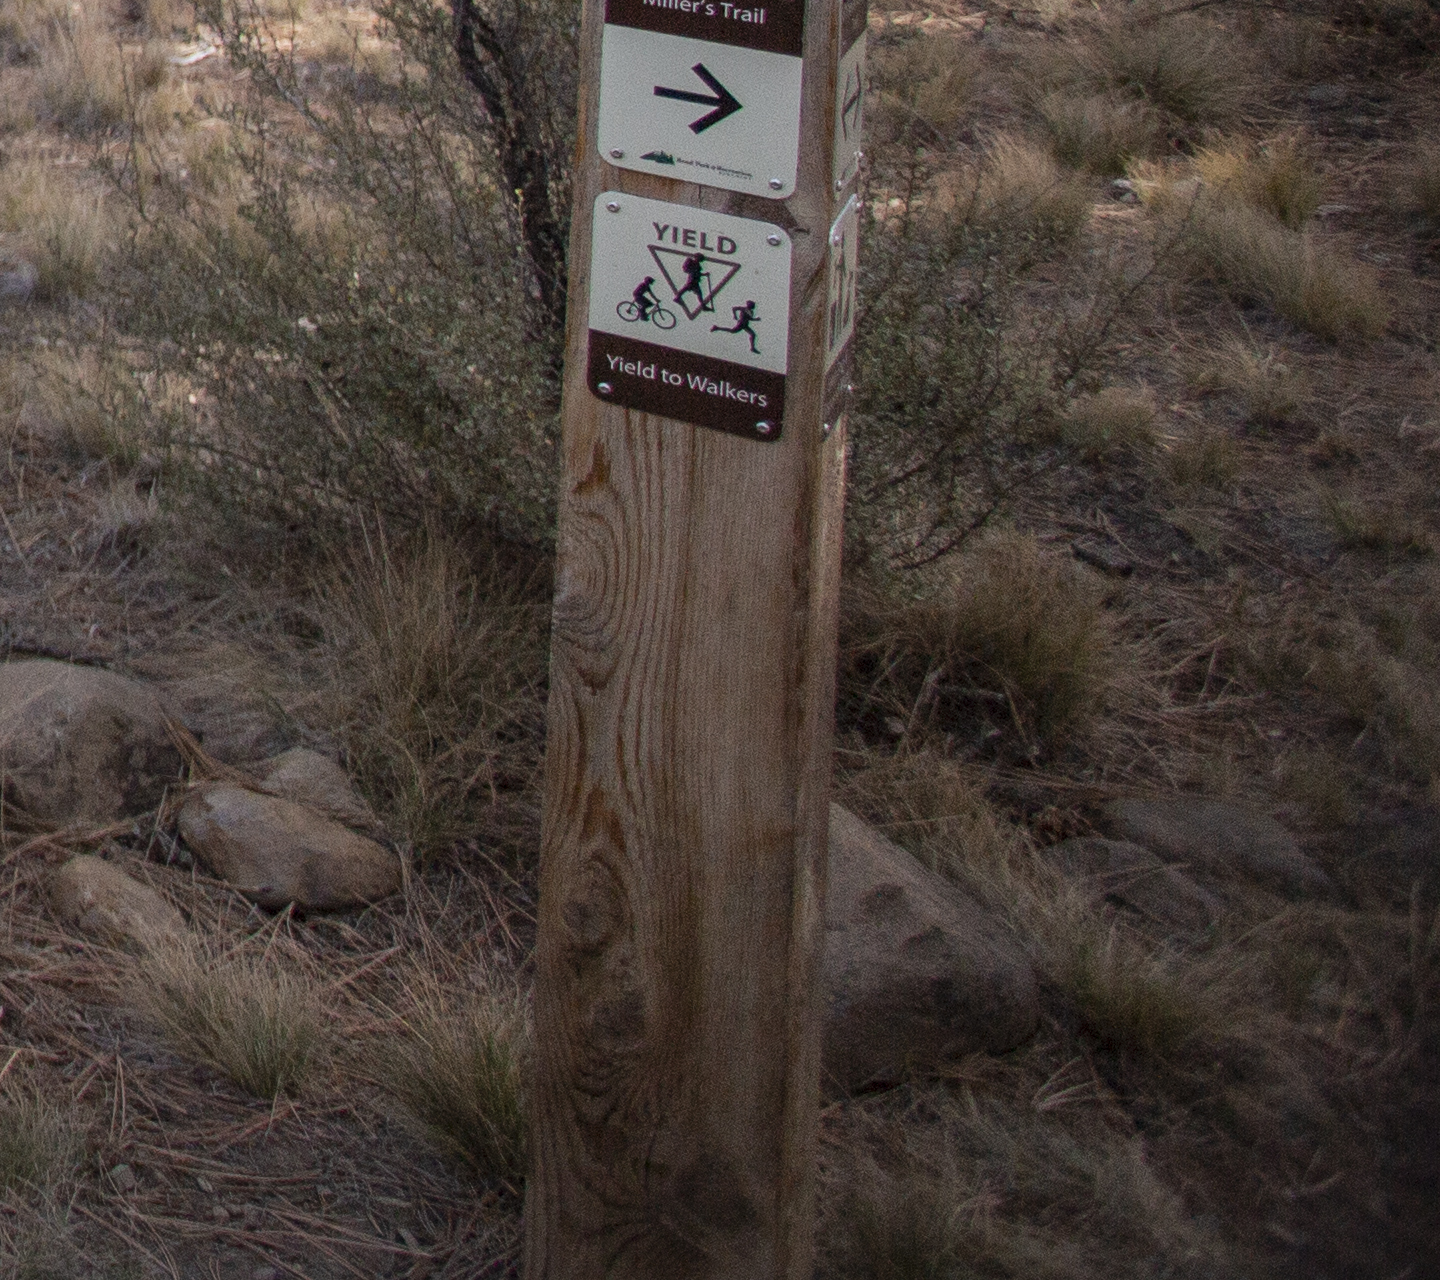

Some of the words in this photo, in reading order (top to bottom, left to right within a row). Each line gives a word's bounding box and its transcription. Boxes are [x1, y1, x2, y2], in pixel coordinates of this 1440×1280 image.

[721, 2, 764, 23] Trail
[653, 223, 737, 254] YIELD
[607, 354, 655, 379] Yield
[662, 364, 682, 385] to
[687, 374, 767, 407] Walkers
